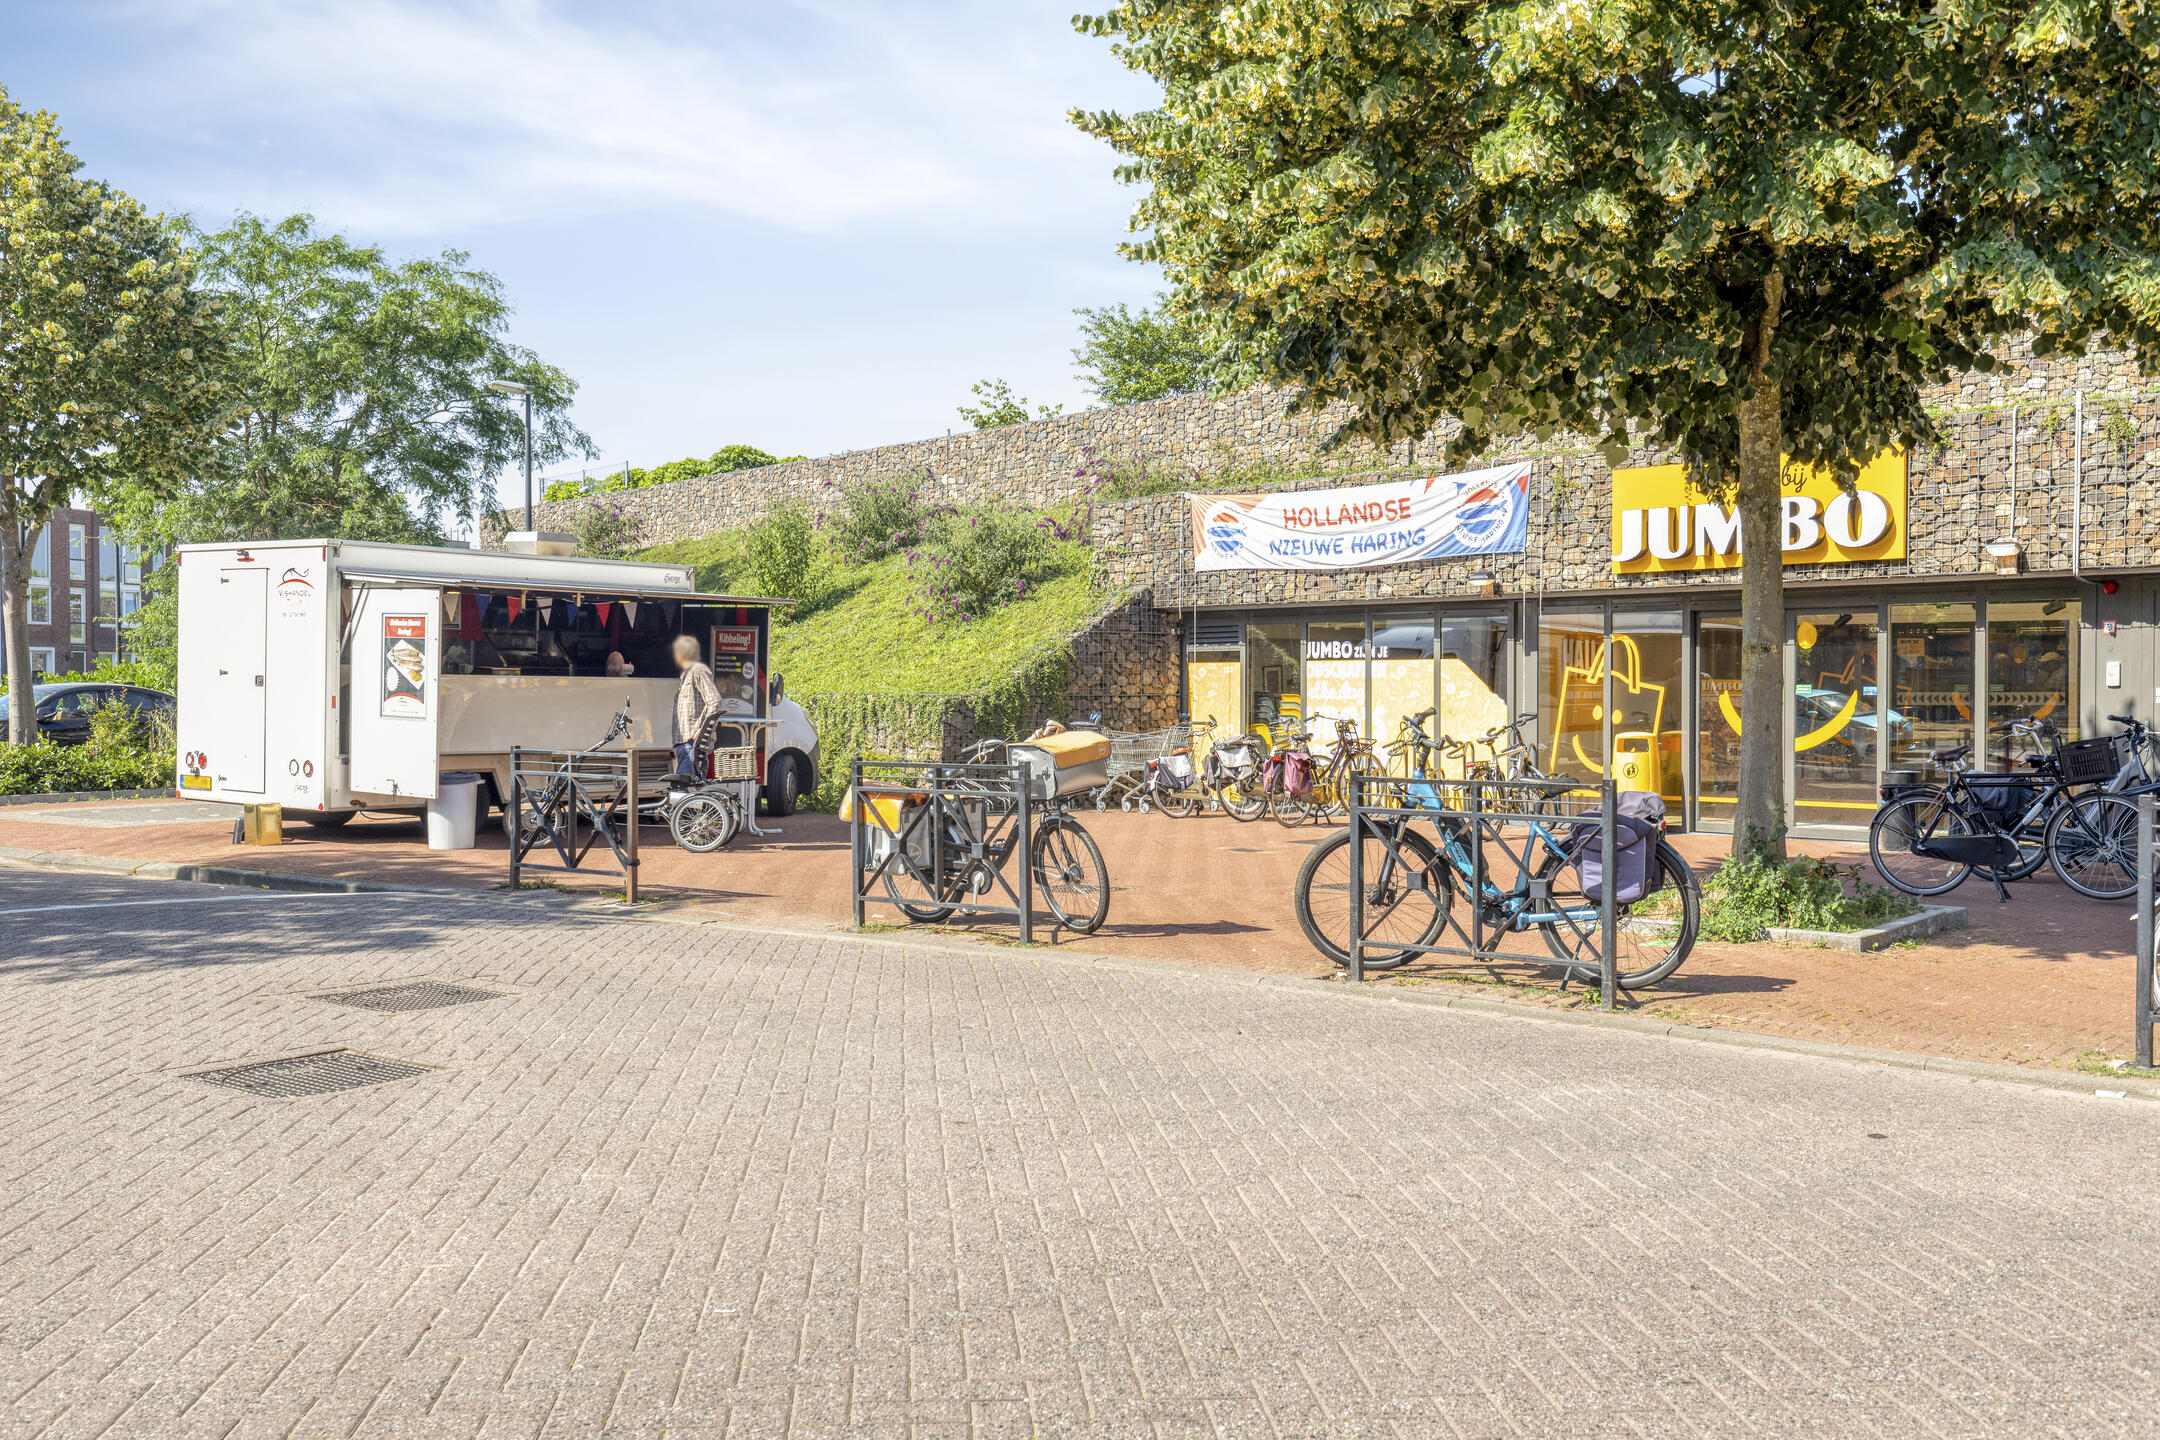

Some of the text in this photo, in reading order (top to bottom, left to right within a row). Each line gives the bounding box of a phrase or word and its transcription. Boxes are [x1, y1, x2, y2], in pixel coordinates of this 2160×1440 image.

[1283, 497, 1411, 529] HOLLANDSE
[1612, 490, 1889, 562] JUMBO
[1269, 537, 1345, 556] NIEUWE
[1351, 528, 1426, 554] HARING
[719, 633, 751, 647] Kibbeling!
[1306, 641, 1353, 659] JUMBO
[1377, 645, 1388, 659] JE
